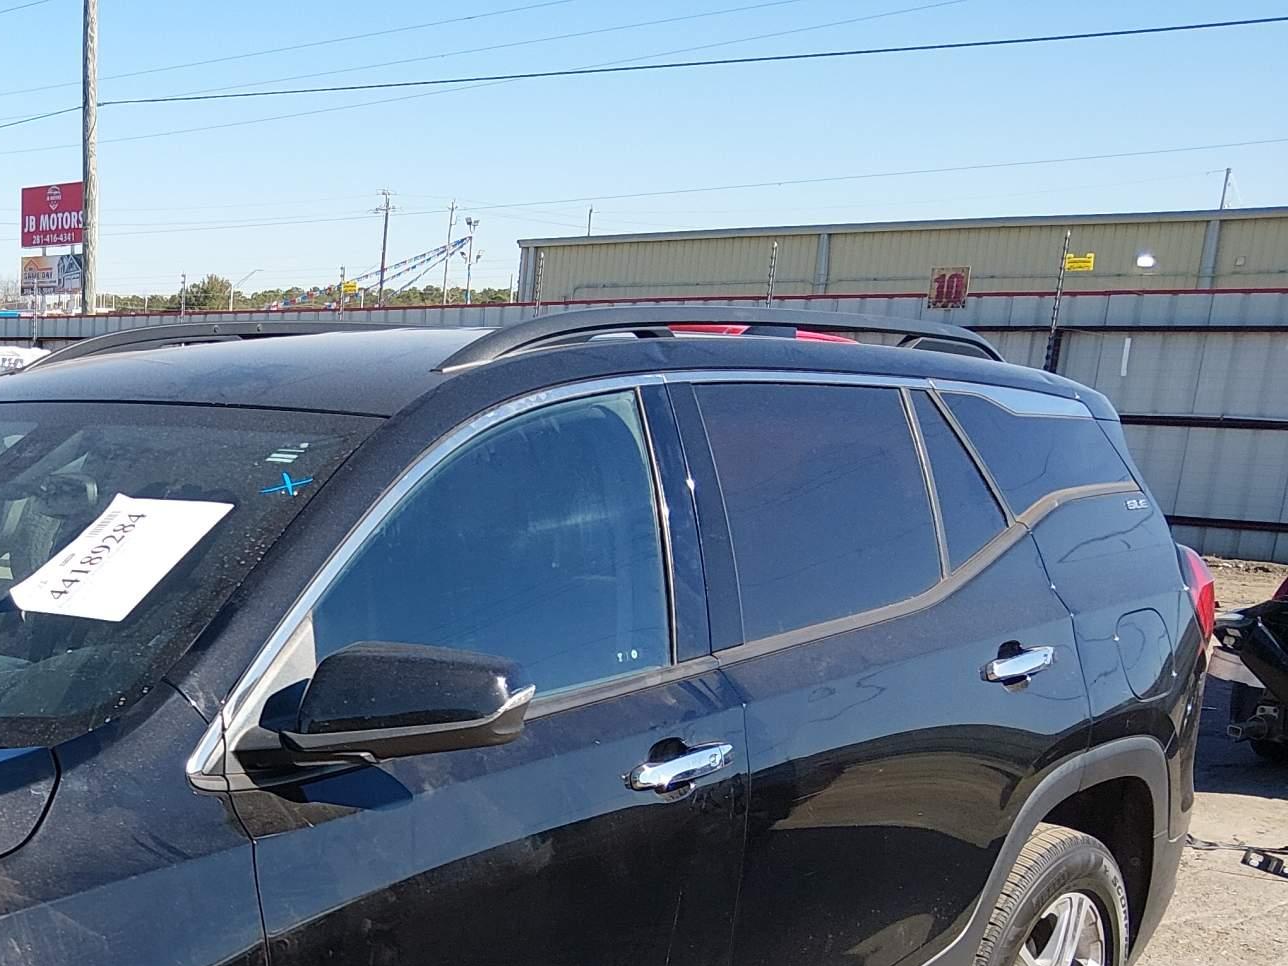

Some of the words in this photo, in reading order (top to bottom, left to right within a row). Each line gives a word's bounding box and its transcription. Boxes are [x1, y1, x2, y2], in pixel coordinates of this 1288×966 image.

[24, 215, 36, 233] JB
[39, 211, 83, 231] MOTORS
[934, 273, 964, 304] 10
[1126, 500, 1149, 510] SLE
[50, 513, 146, 600] 44189284
